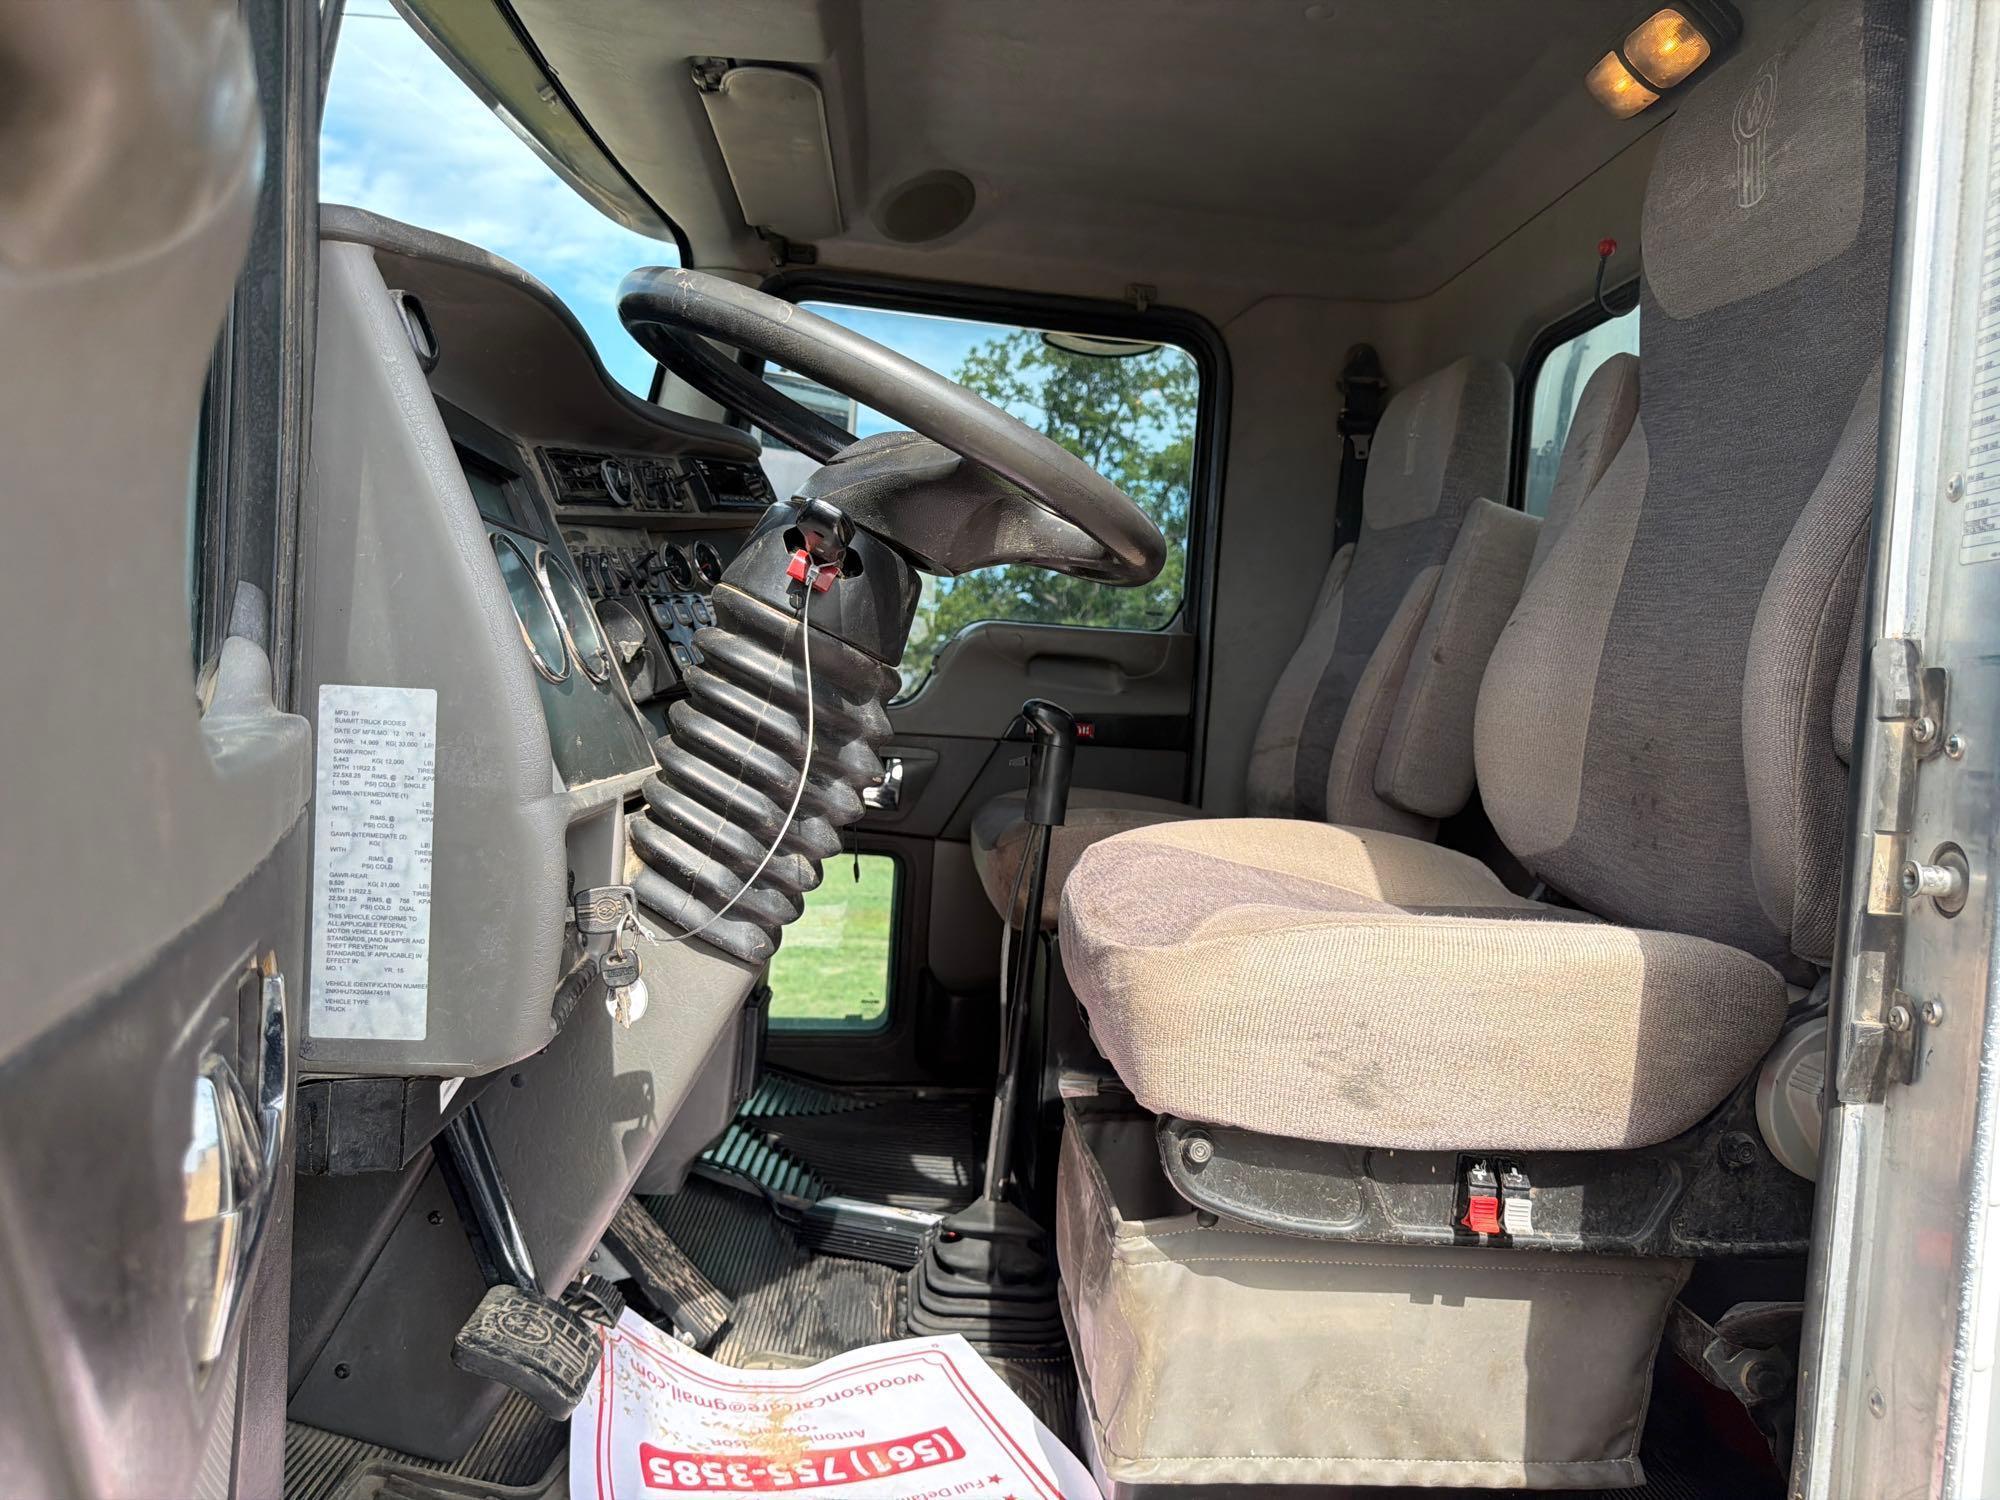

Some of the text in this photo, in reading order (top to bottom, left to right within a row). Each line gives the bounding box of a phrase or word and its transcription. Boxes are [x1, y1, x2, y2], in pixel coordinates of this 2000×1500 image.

[630, 1357, 924, 1413] woodsoncarcare@gmail.com
[649, 1434, 955, 1488] (561) 755-3585
[953, 1480, 985, 1495] Full
